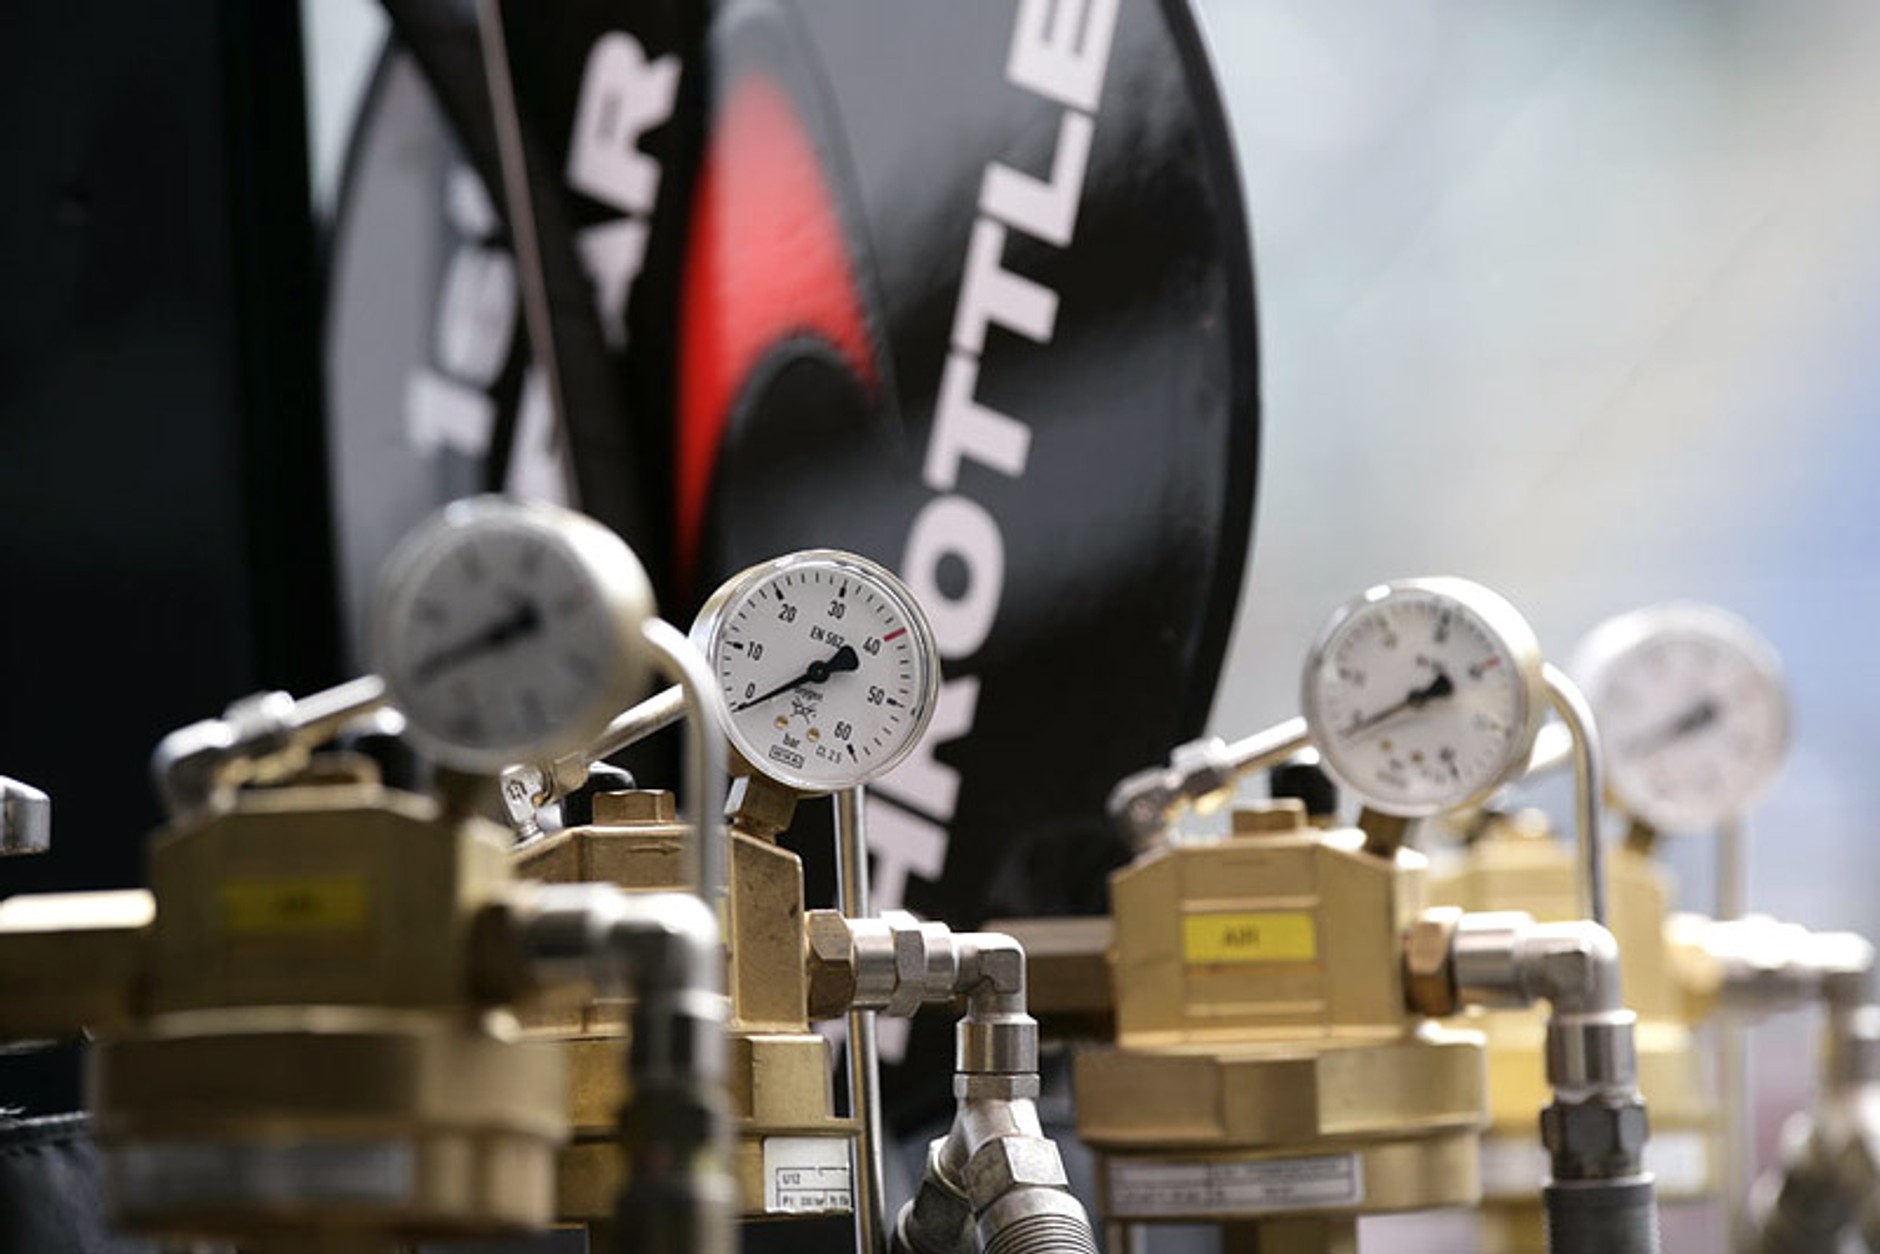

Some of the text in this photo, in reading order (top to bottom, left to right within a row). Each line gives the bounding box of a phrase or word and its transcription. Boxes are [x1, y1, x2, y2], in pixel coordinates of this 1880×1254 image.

[778, 603, 798, 623] 20
[827, 601, 845, 620] 30
[809, 625, 825, 641] EN
[747, 641, 763, 661] 10
[862, 636, 881, 656] 40
[745, 683, 755, 698] 0
[867, 685, 885, 705] 50
[782, 732, 801, 749] bar
[834, 720, 852, 741] 60
